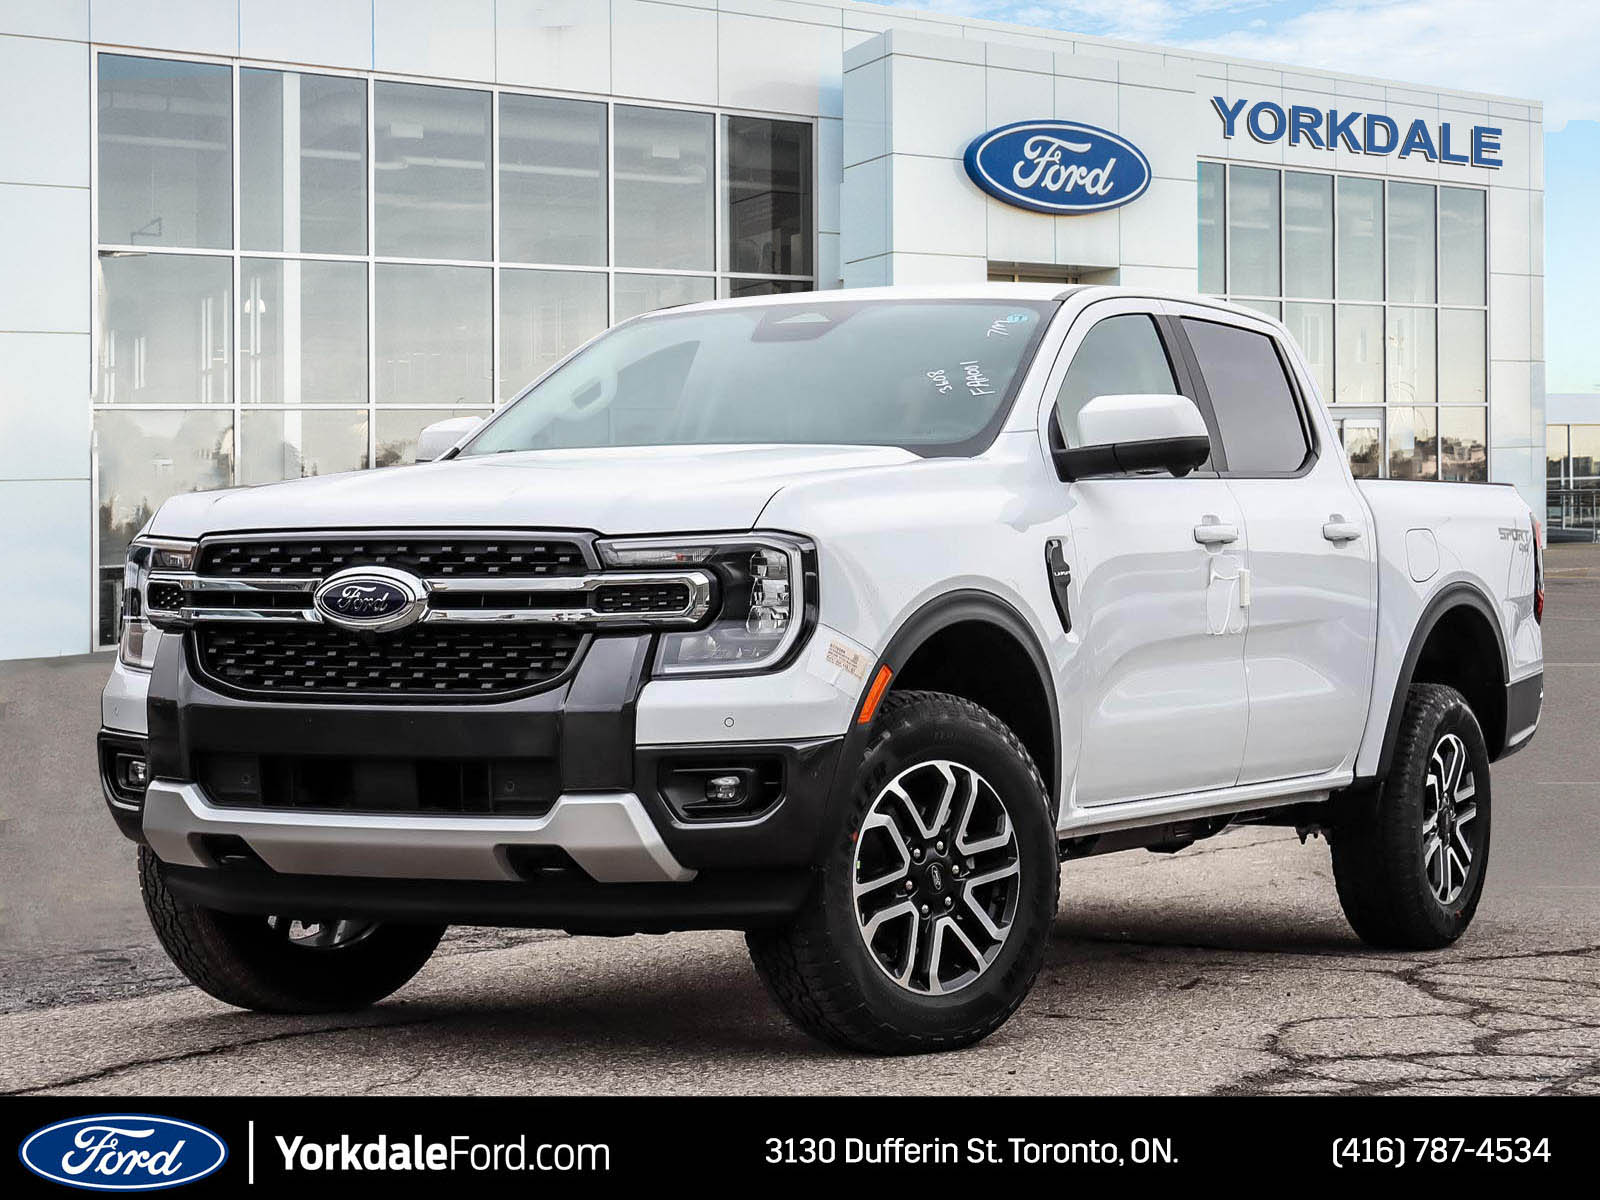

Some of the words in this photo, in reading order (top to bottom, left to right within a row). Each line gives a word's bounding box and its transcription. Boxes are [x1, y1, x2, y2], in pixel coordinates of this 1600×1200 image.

[1211, 96, 1503, 169] YORKDALE
[1012, 135, 1117, 196] Ford
[1498, 527, 1530, 543] SPORT
[337, 585, 390, 612] Ford
